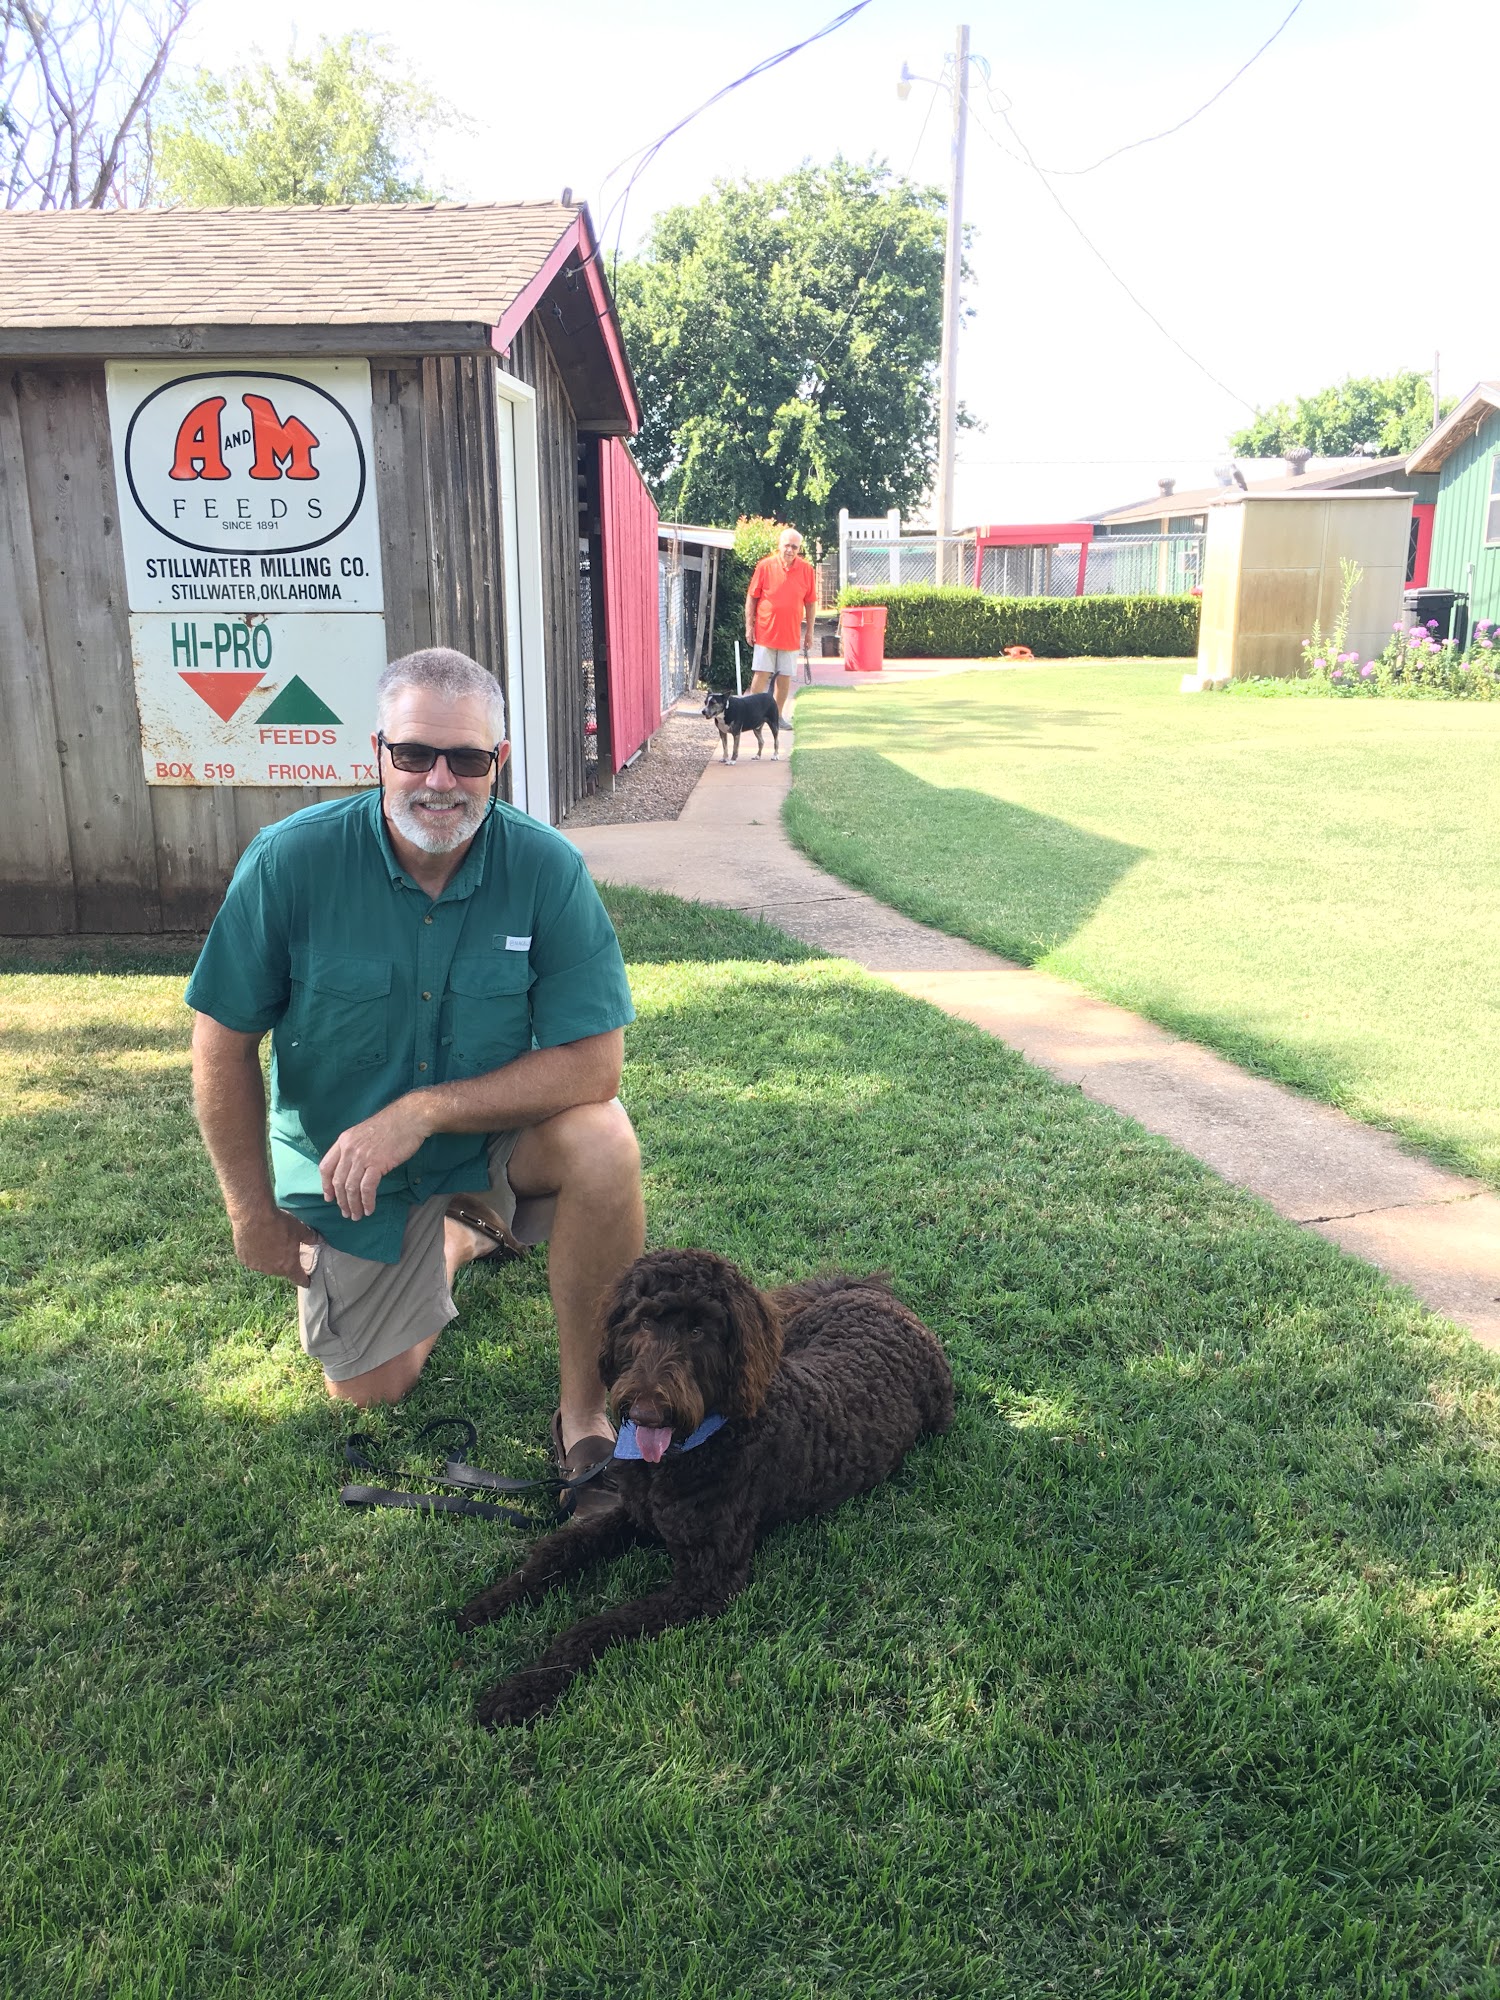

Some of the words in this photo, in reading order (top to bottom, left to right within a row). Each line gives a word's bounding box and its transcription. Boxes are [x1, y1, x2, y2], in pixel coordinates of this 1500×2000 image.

[168, 396, 231, 480] A
[224, 429, 251, 451] AND
[242, 393, 320, 480] M
[173, 498, 322, 519] FEEDS
[222, 521, 252, 530] SINCE
[257, 521, 279, 530] 1891
[146, 558, 251, 578] STILLWATER
[260, 557, 331, 578] MILLING
[341, 557, 369, 577] CO.
[171, 622, 273, 670] HI-PRO
[259, 729, 337, 745] FEEDS
[156, 762, 195, 778] BOX
[204, 763, 235, 778] 519
[268, 764, 341, 780] FRIONA,
